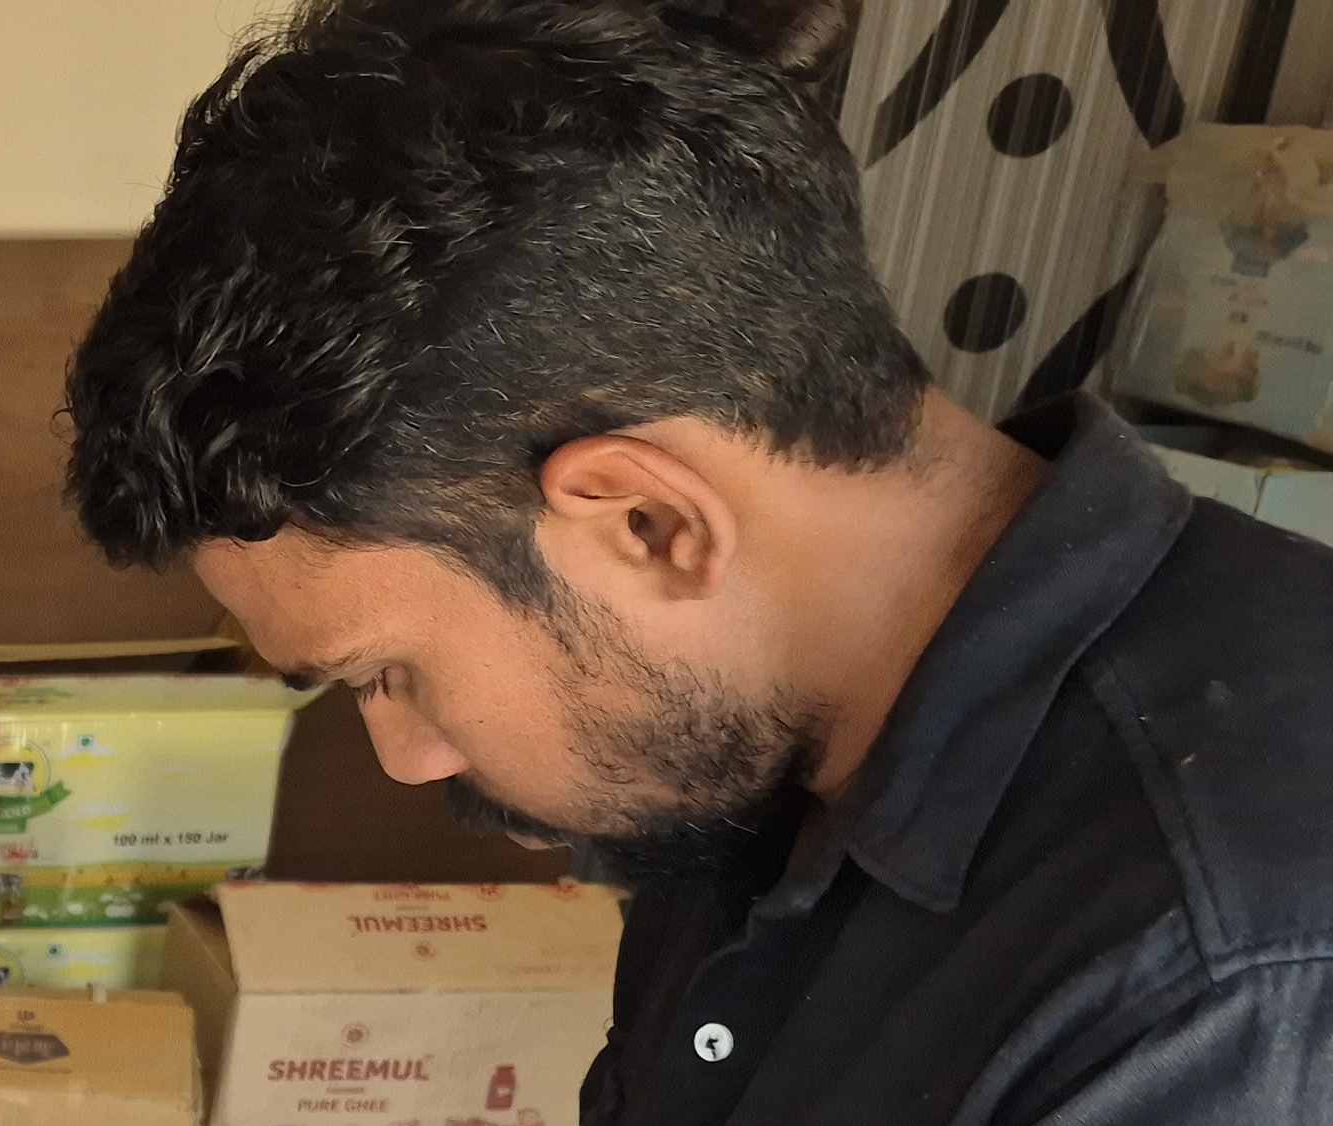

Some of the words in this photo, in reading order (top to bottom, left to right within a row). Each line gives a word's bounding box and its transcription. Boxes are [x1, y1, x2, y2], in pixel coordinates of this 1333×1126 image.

[352, 914, 489, 933] SHREEMUL
[267, 1058, 430, 1082] SHREEMUL
[297, 1099, 340, 1113] PURE
[344, 1099, 390, 1113] GHEE
